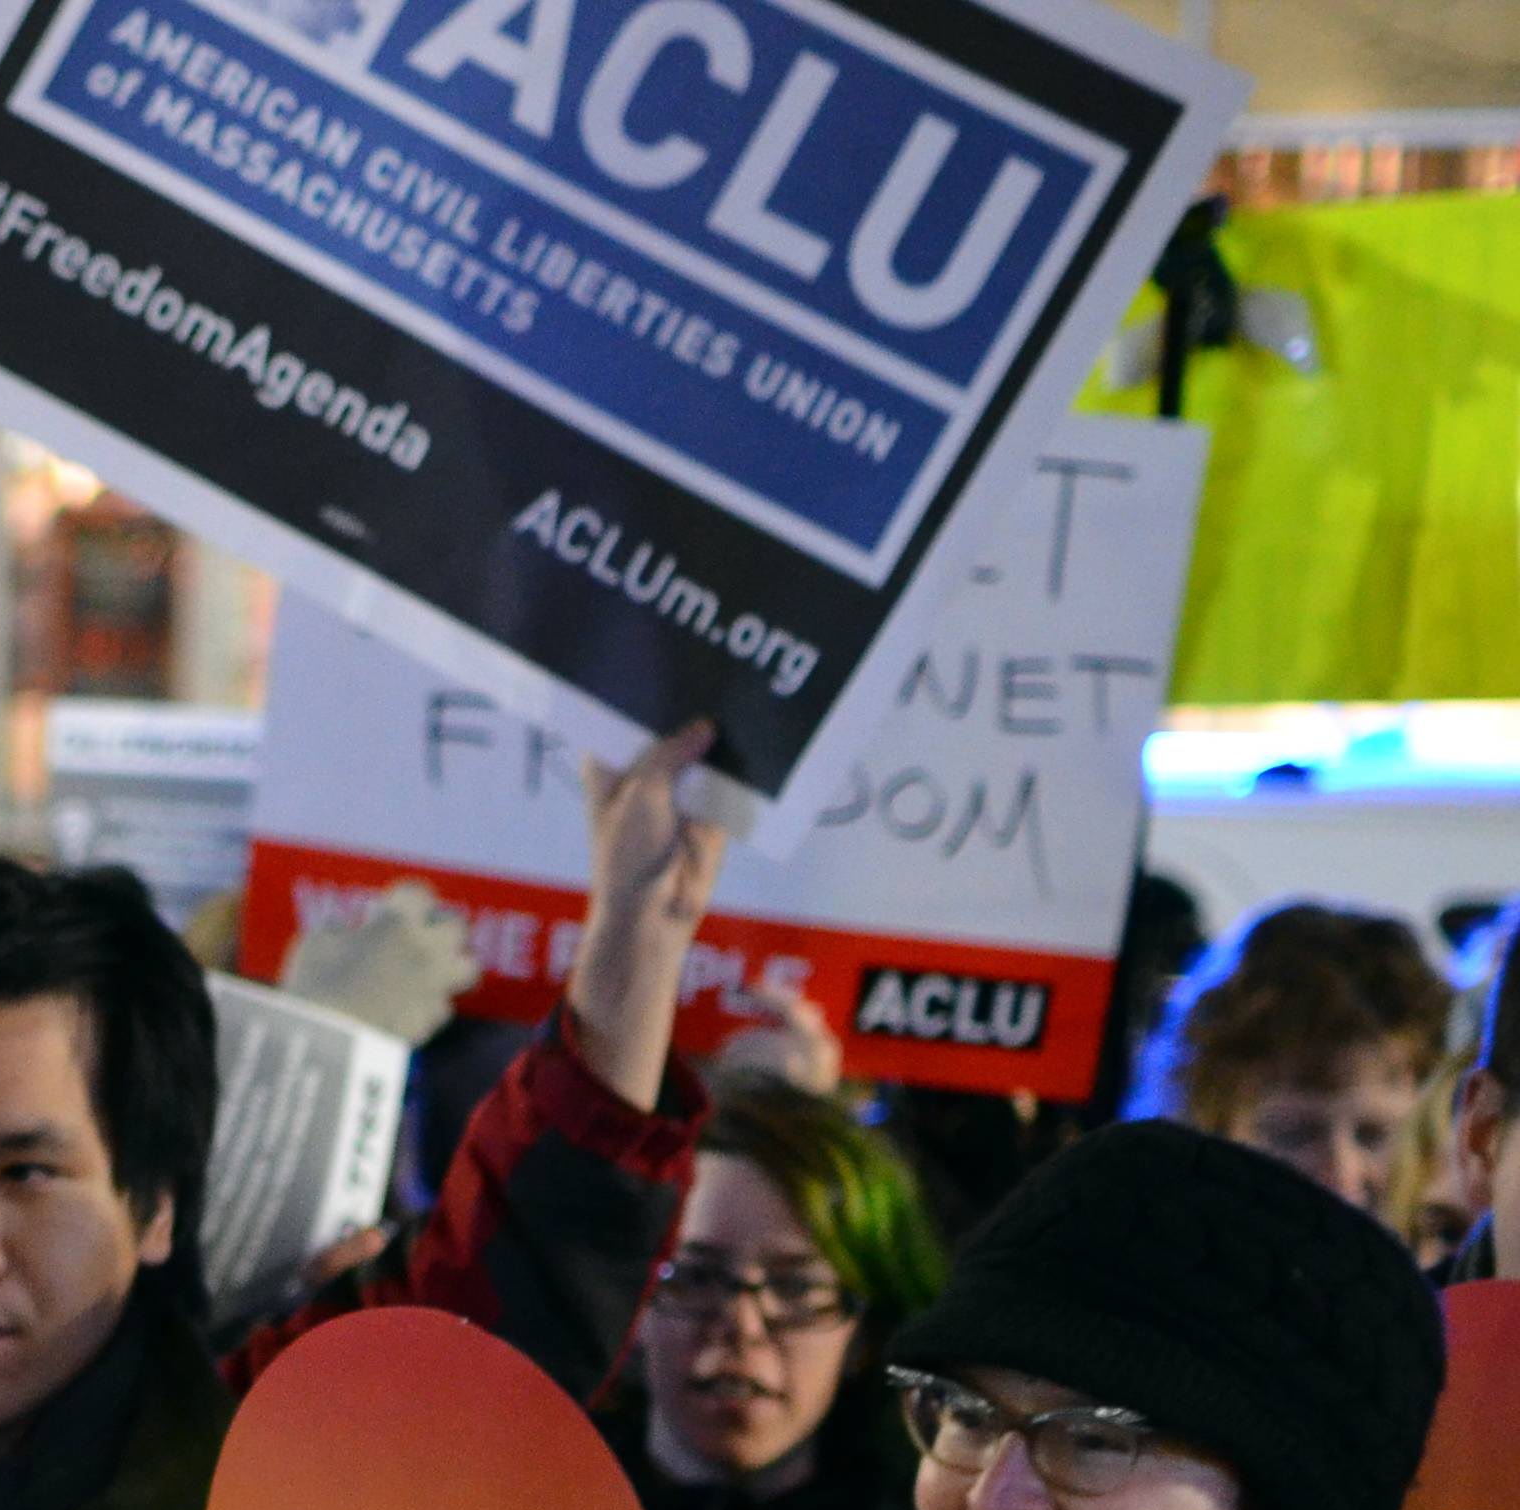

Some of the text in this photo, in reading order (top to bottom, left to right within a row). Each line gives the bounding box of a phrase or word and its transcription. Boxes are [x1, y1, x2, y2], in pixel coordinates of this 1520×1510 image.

[86, 63, 542, 335] of MASSACHUSETTS
[111, 9, 902, 464] AMERICAN CIVIL LIBERTIES UNION
[407, 0, 1044, 332] ACLU
[512, 485, 823, 697] ACLUm.org
[894, 645, 1155, 737] NET
[858, 968, 1046, 1050] ACLU
